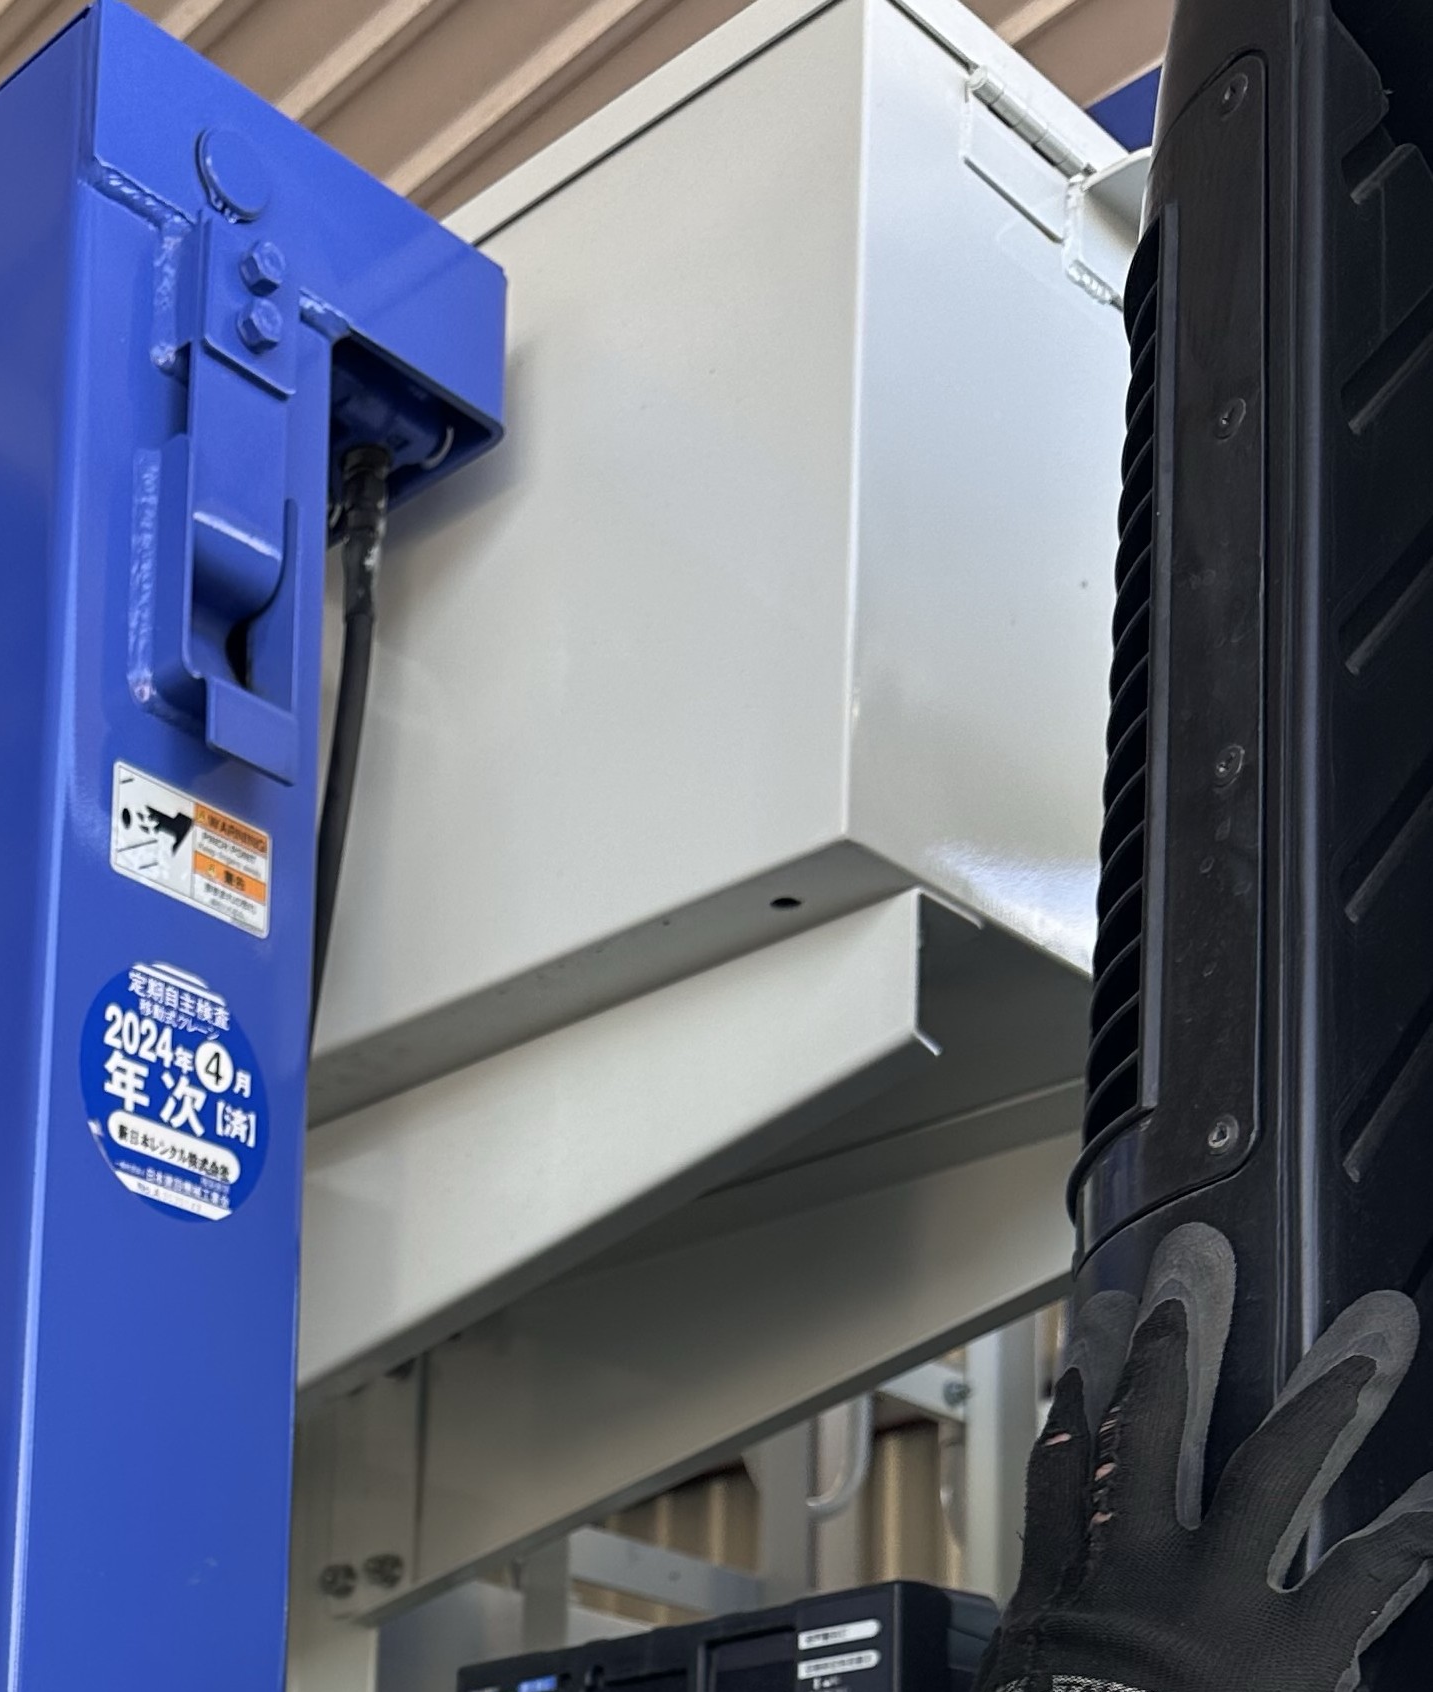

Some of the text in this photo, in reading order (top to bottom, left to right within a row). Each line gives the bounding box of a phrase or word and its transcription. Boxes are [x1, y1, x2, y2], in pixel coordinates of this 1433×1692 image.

[128, 970, 231, 1032] 定期自主検査
